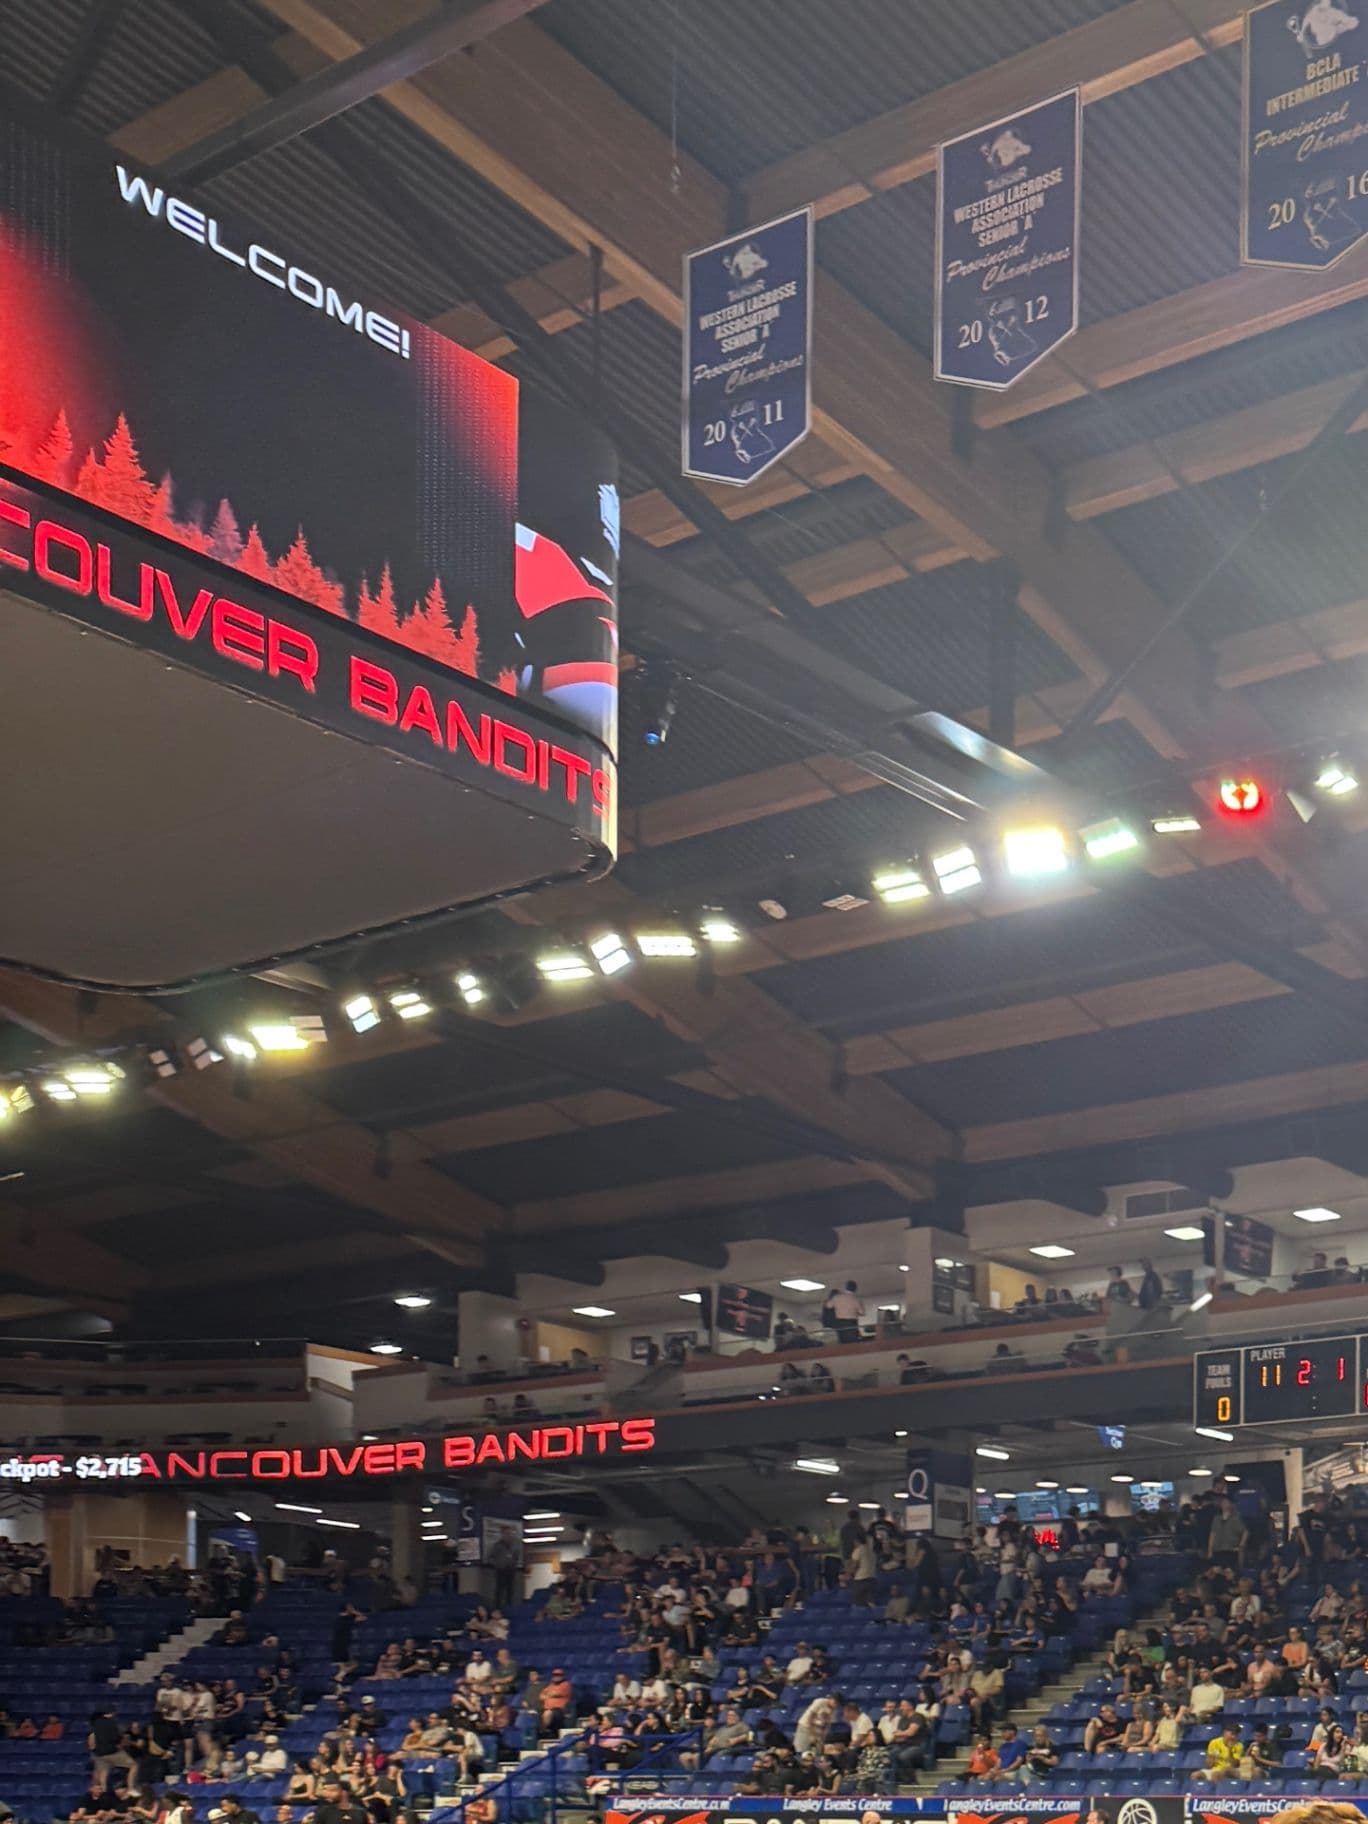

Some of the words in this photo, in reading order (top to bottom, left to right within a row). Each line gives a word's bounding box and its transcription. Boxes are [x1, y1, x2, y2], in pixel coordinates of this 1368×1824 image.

[1306, 53, 1340, 80] BCLA
[1267, 64, 1360, 117] INTERMEDIATE
[1254, 101, 1350, 155] Provincial
[1268, 198, 1295, 231] 20
[116, 163, 412, 359] WELCOME!
[958, 320, 983, 349] 20
[1024, 296, 1049, 324] 12
[704, 420, 725, 446] 20
[763, 400, 783, 425] 11
[350, 655, 611, 819] BANDITS
[1207, 1364, 1231, 1377] TEAM
[1250, 1348, 1286, 1362] PLAYER
[1296, 1359, 1311, 1386] 2
[1217, 1396, 1231, 1422] 0
[444, 1418, 656, 1468] BANDITS
[76, 1456, 142, 1479] $2,715
